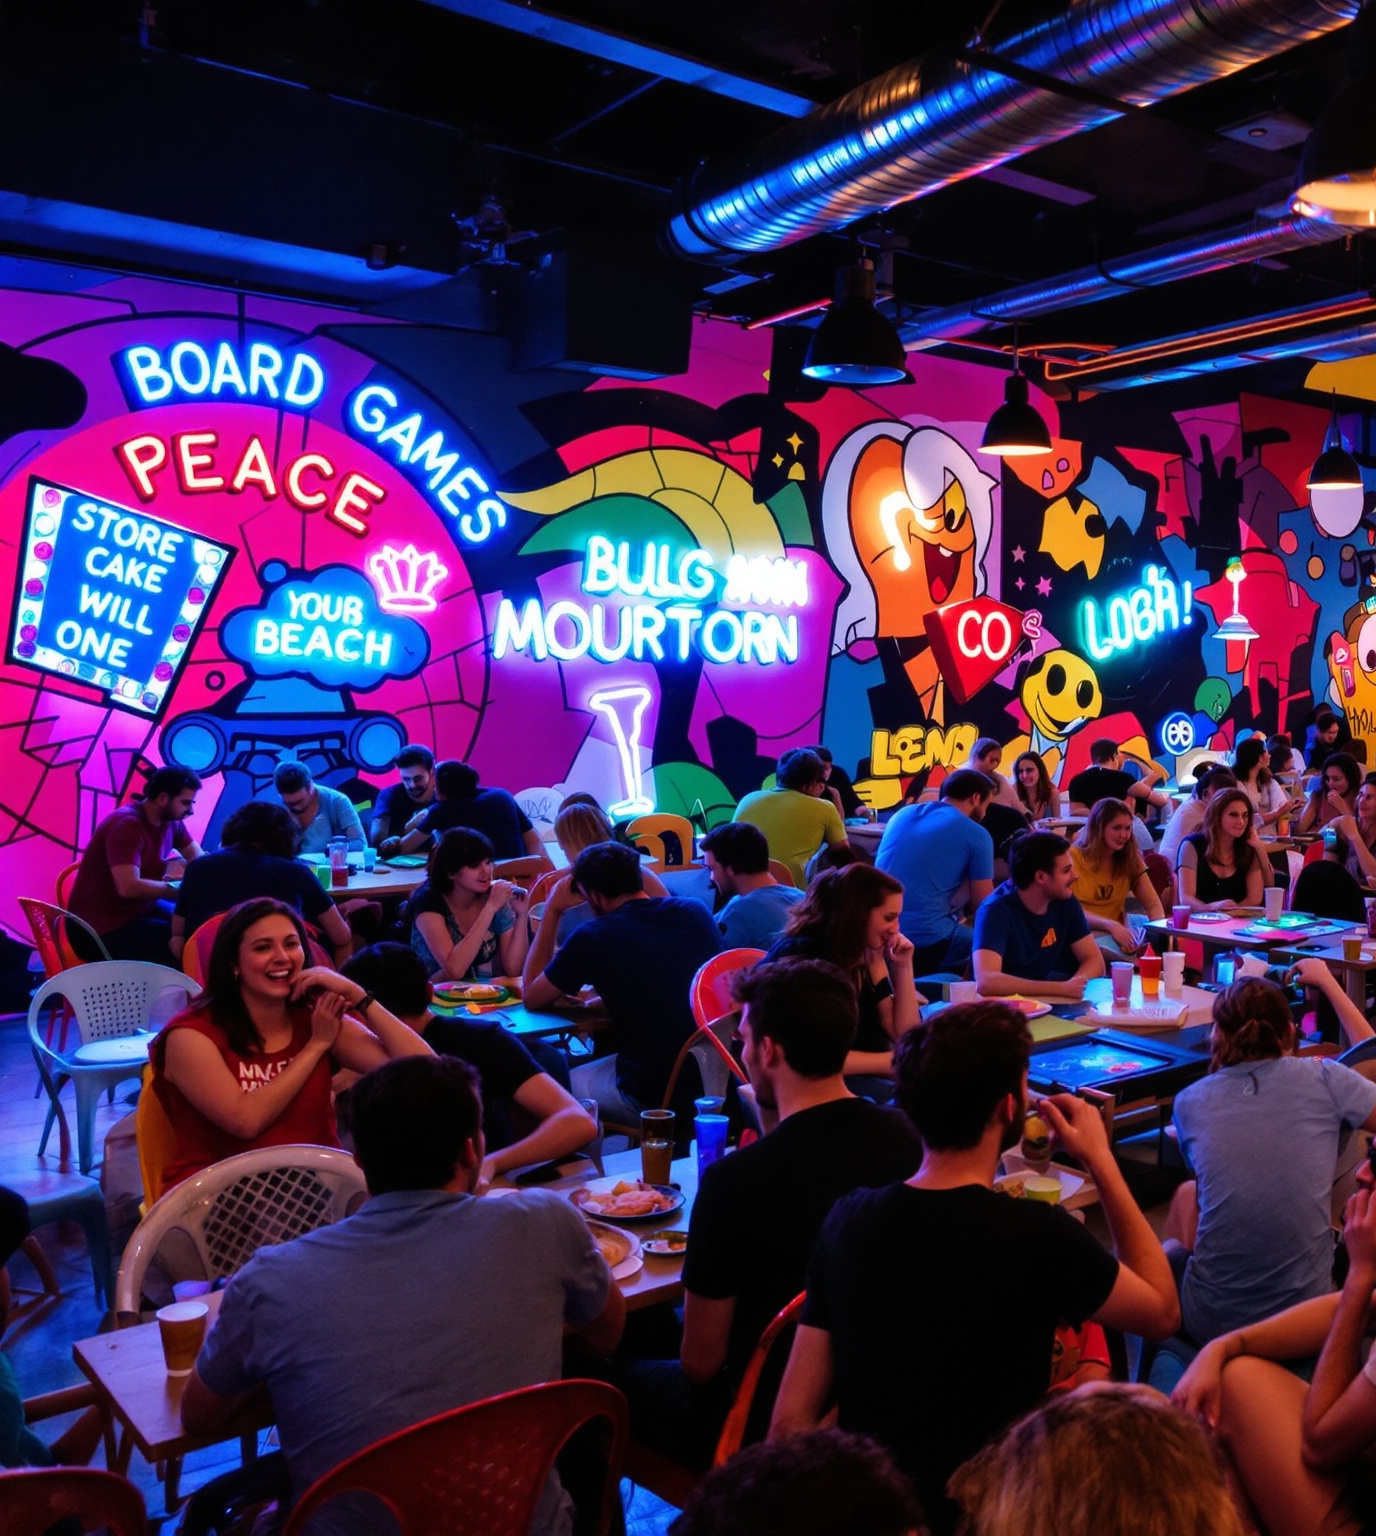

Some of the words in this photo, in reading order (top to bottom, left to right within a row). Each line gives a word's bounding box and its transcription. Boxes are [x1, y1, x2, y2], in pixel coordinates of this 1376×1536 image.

[127, 341, 325, 406] BOARD
[353, 385, 507, 543] GAMES
[119, 432, 386, 535] PEACE
[72, 502, 185, 564] STORE
[84, 546, 169, 594] CAKE
[78, 583, 154, 636] WILL
[491, 597, 798, 666] MOURTORN
[957, 609, 1012, 661] CO
[55, 619, 134, 669] ONE
[254, 618, 393, 667] BEACH
